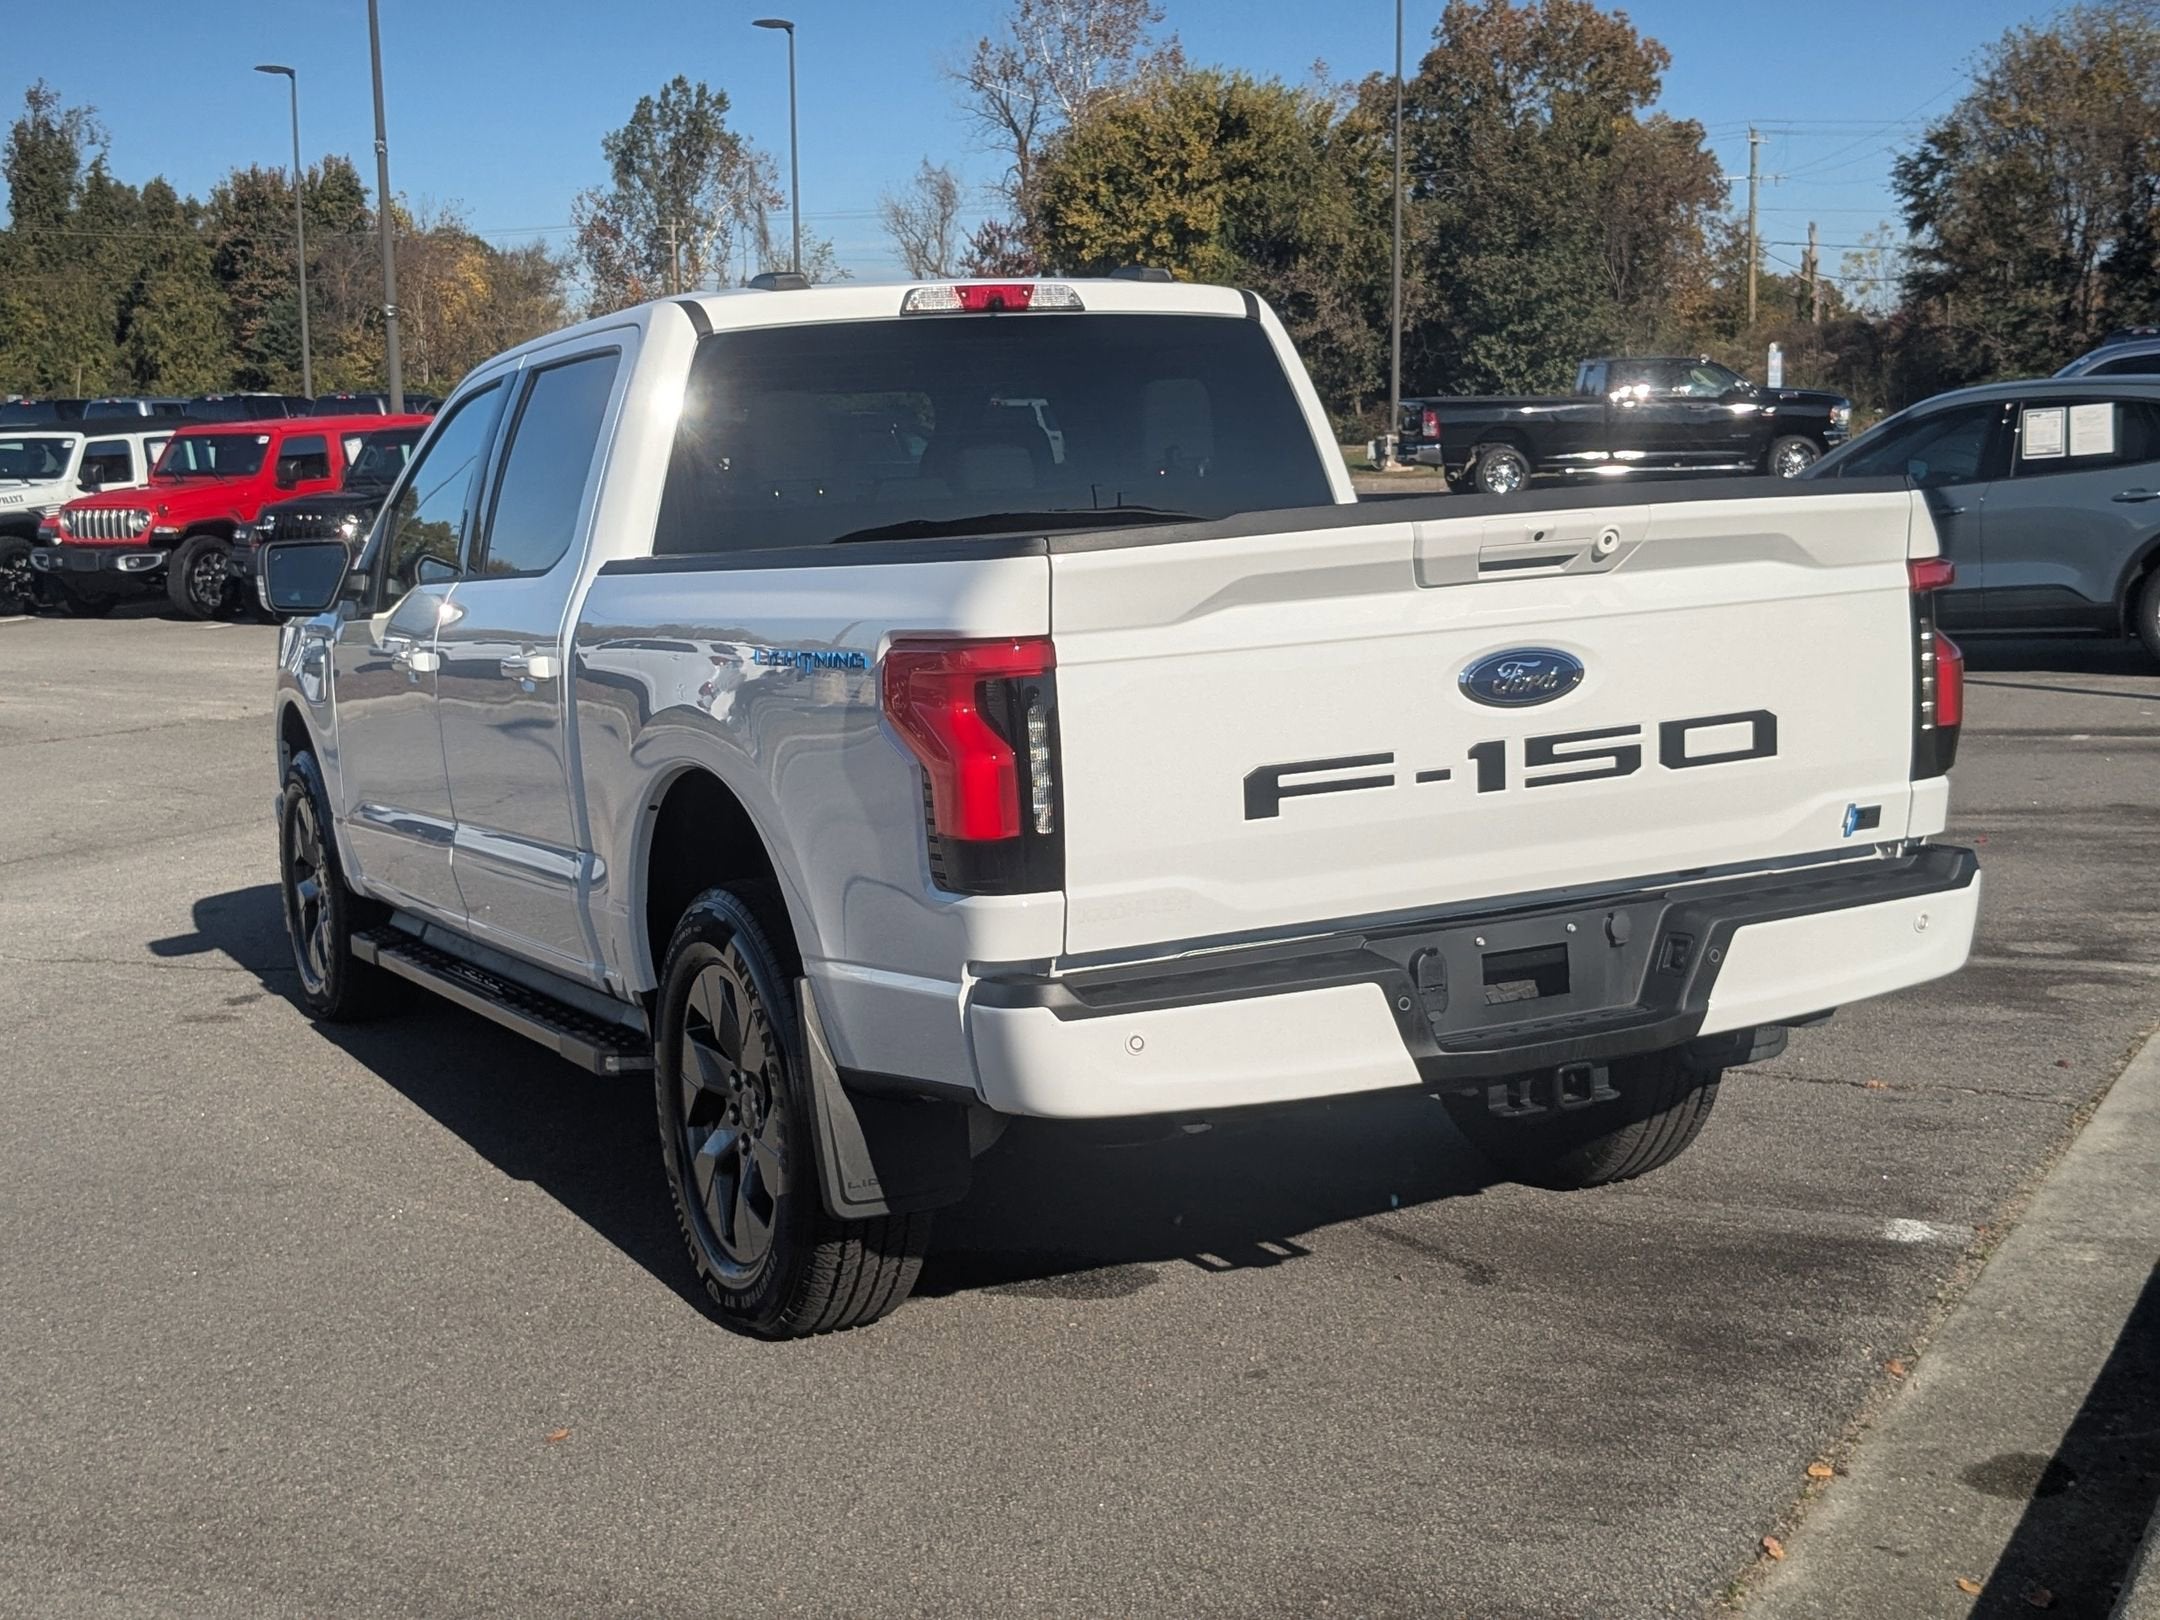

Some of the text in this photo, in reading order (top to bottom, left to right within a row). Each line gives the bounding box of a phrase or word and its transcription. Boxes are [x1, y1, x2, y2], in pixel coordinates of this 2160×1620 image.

[0, 494, 25, 505] ILLYS
[754, 649, 870, 675] LIGHTNING
[1243, 709, 1778, 821] F-150
